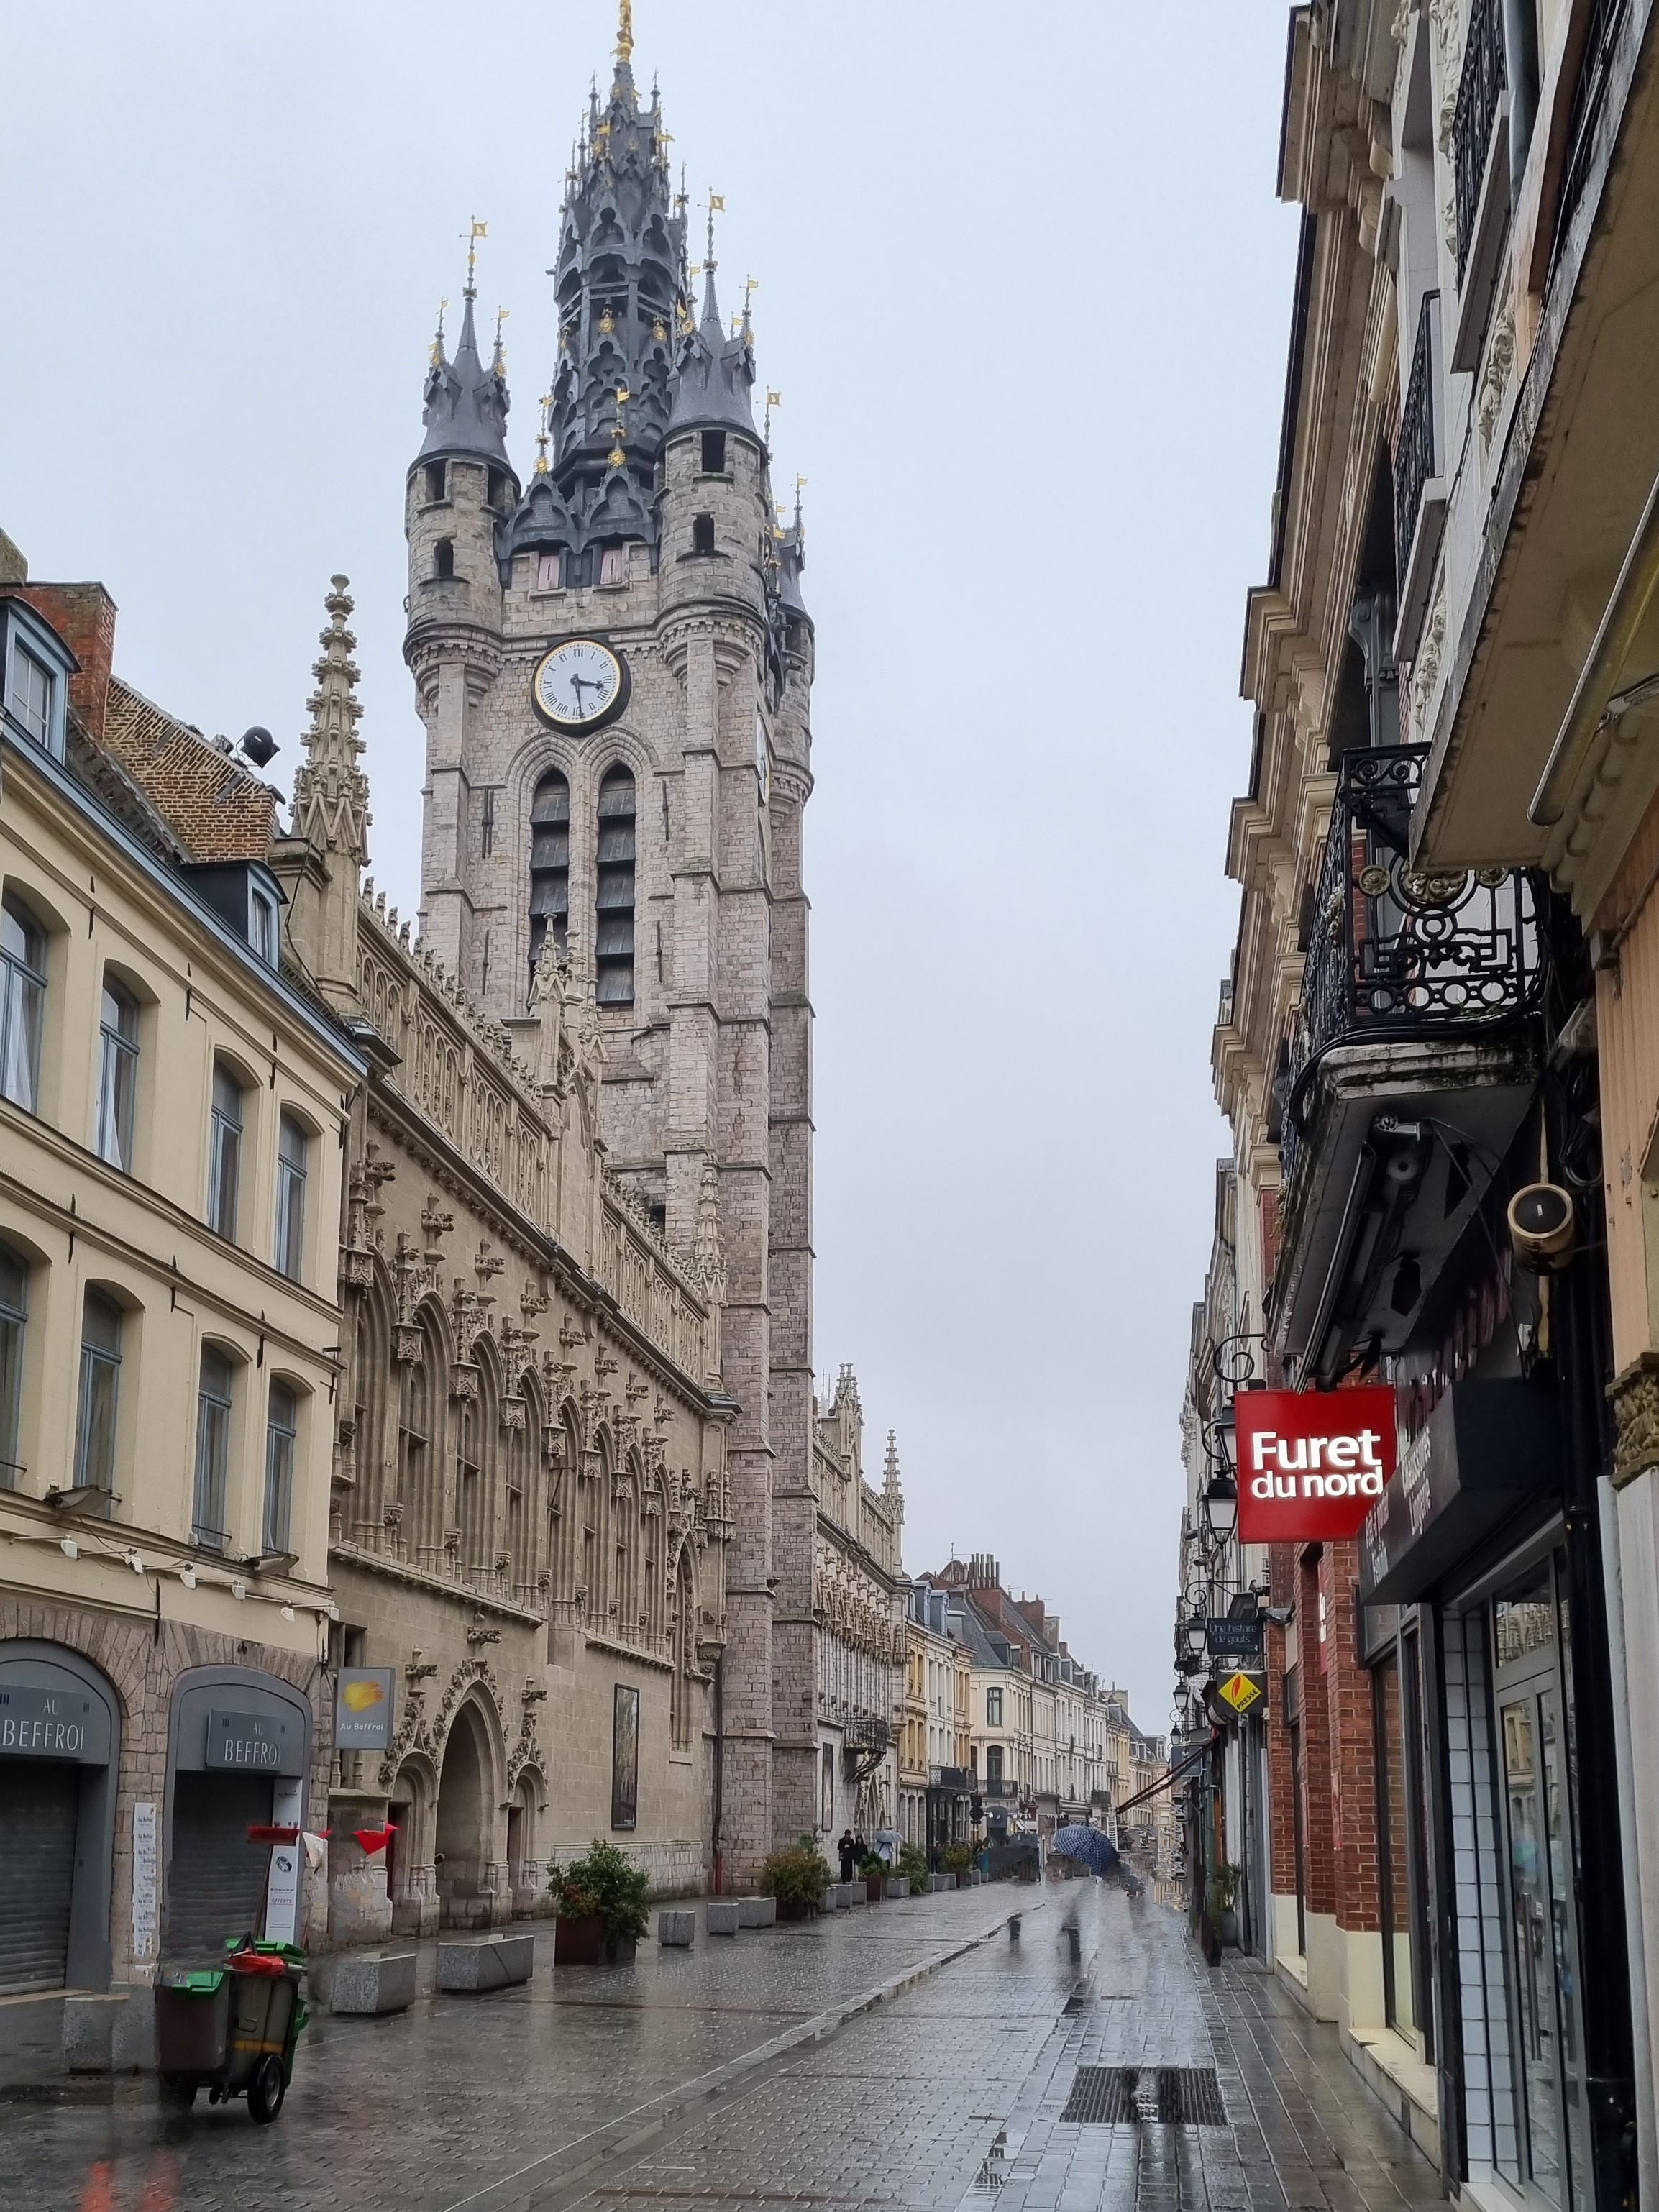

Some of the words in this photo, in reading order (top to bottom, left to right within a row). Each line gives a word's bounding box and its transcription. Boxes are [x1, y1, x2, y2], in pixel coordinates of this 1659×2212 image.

[599, 661, 609, 670] II
[1252, 1429, 1382, 1471] Furet
[1251, 1470, 1297, 1499] du
[1303, 1465, 1384, 1498] nord
[1236, 1688, 1258, 1710] PRESSE
[2, 1719, 85, 1751] BEFFROI
